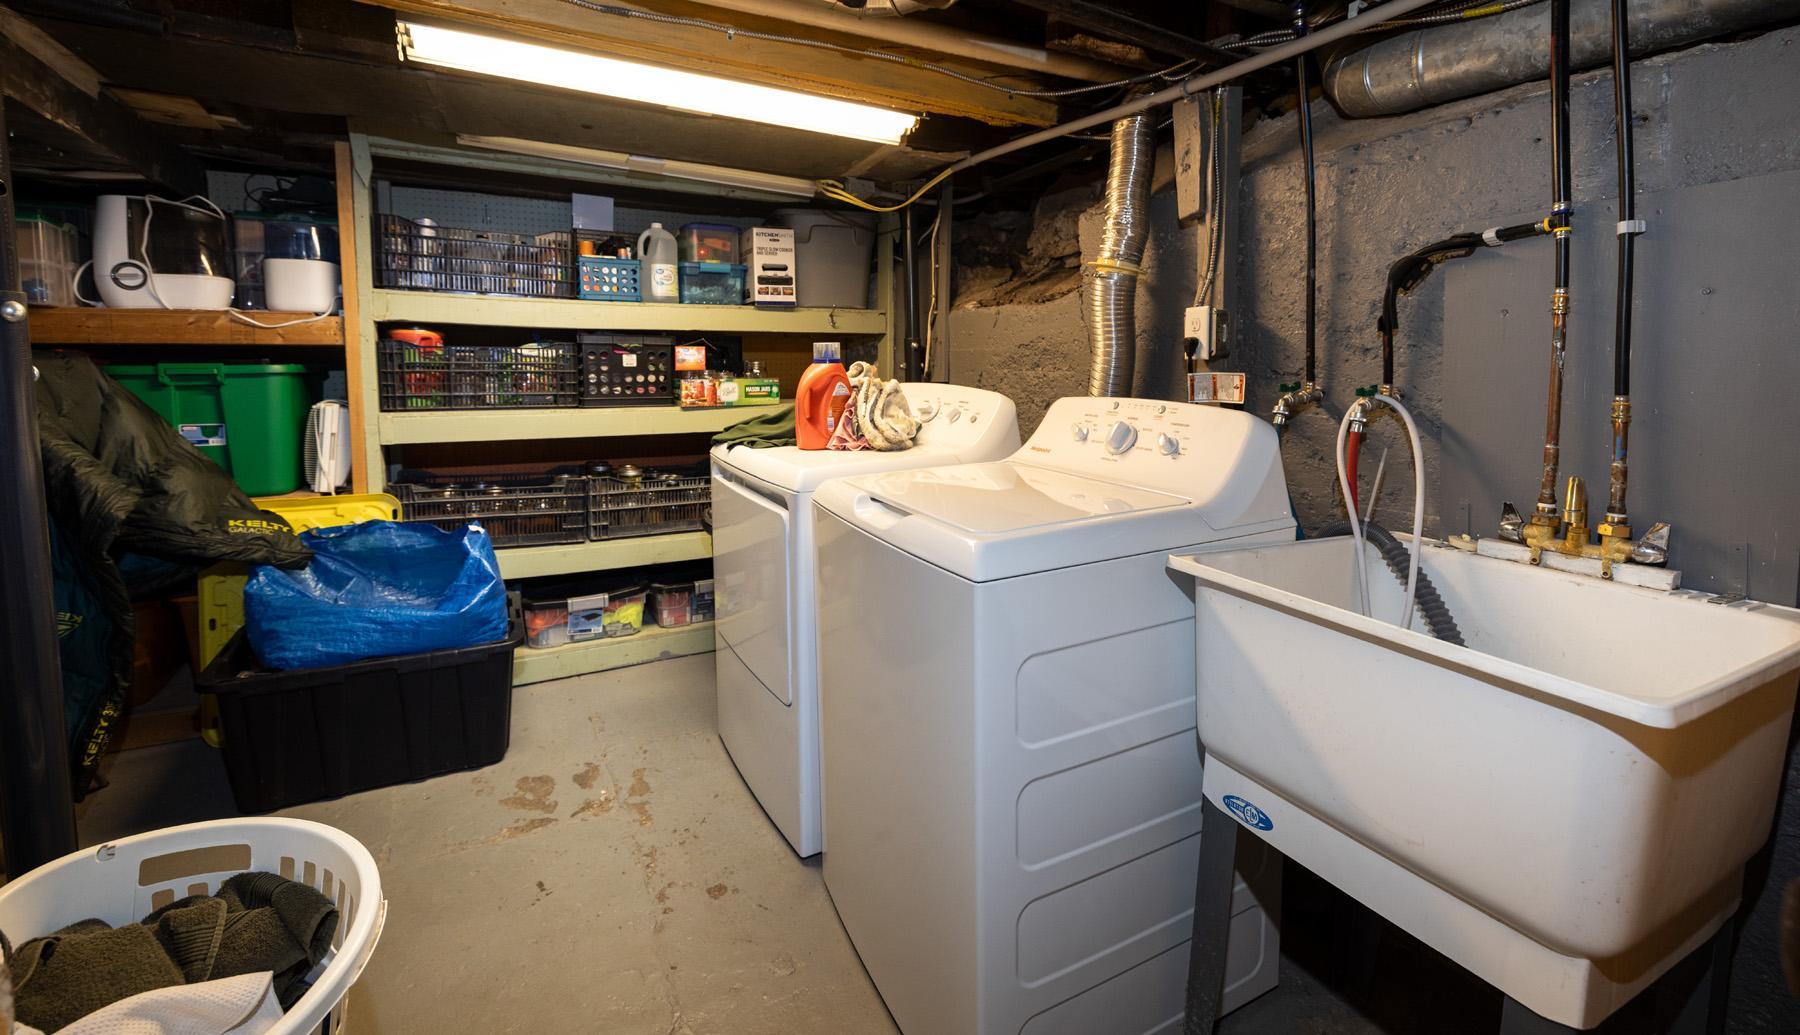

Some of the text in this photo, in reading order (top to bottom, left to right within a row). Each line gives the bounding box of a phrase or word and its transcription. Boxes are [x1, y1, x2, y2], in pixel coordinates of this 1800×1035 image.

[228, 519, 291, 533] KELTY
[228, 526, 275, 535] GALACTIC
[82, 718, 109, 766] KELTY
